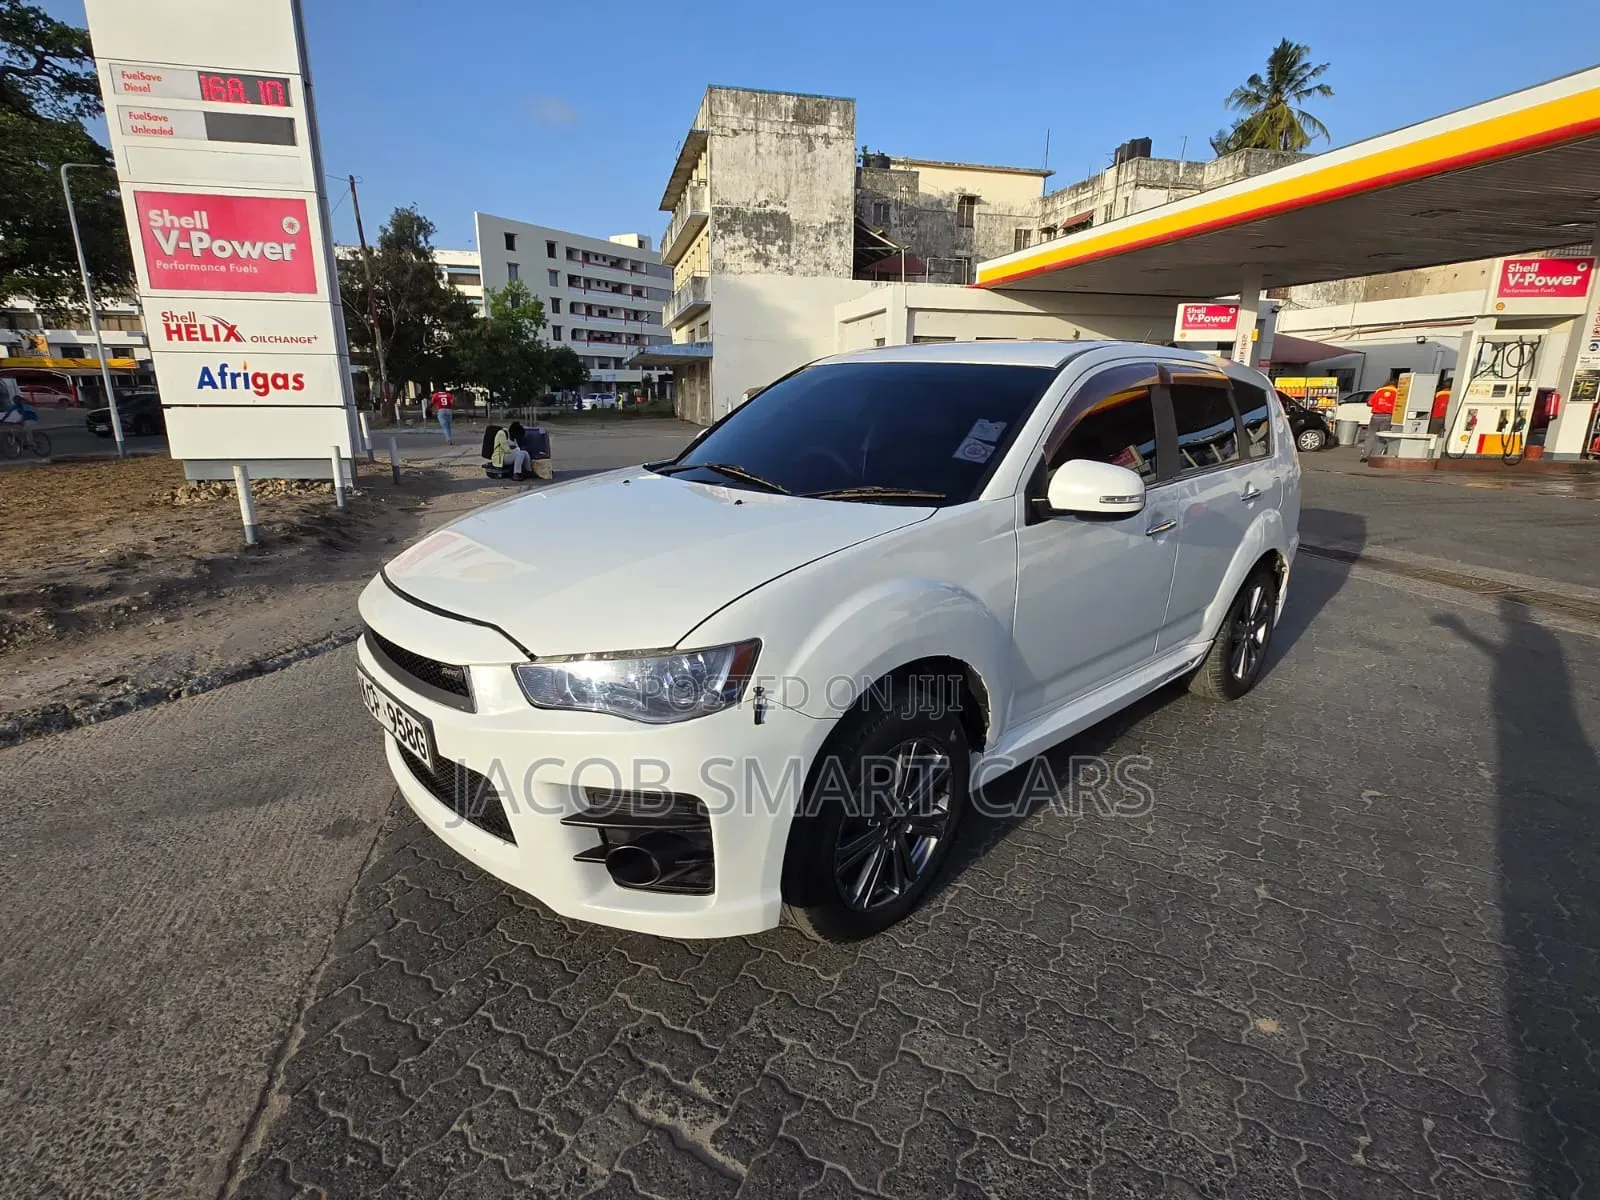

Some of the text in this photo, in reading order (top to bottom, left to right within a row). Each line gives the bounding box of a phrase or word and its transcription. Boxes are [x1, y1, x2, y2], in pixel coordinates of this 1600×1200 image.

[121, 71, 162, 82] FuelSave
[123, 83, 152, 93] Diesel
[128, 111, 168, 123] FuelSave
[131, 125, 174, 136] Unleaded
[148, 208, 209, 230] Shell
[151, 228, 296, 261] V-Power
[155, 259, 258, 274] Performance Fuels
[1507, 263, 1539, 273] Shell
[1507, 273, 1582, 287] V-Power
[161, 311, 196, 323] Shell
[1187, 313, 1232, 323] V-Power
[162, 321, 247, 343] HELIX
[197, 361, 304, 397] Afrigas
[386, 702, 428, 761] 958G
